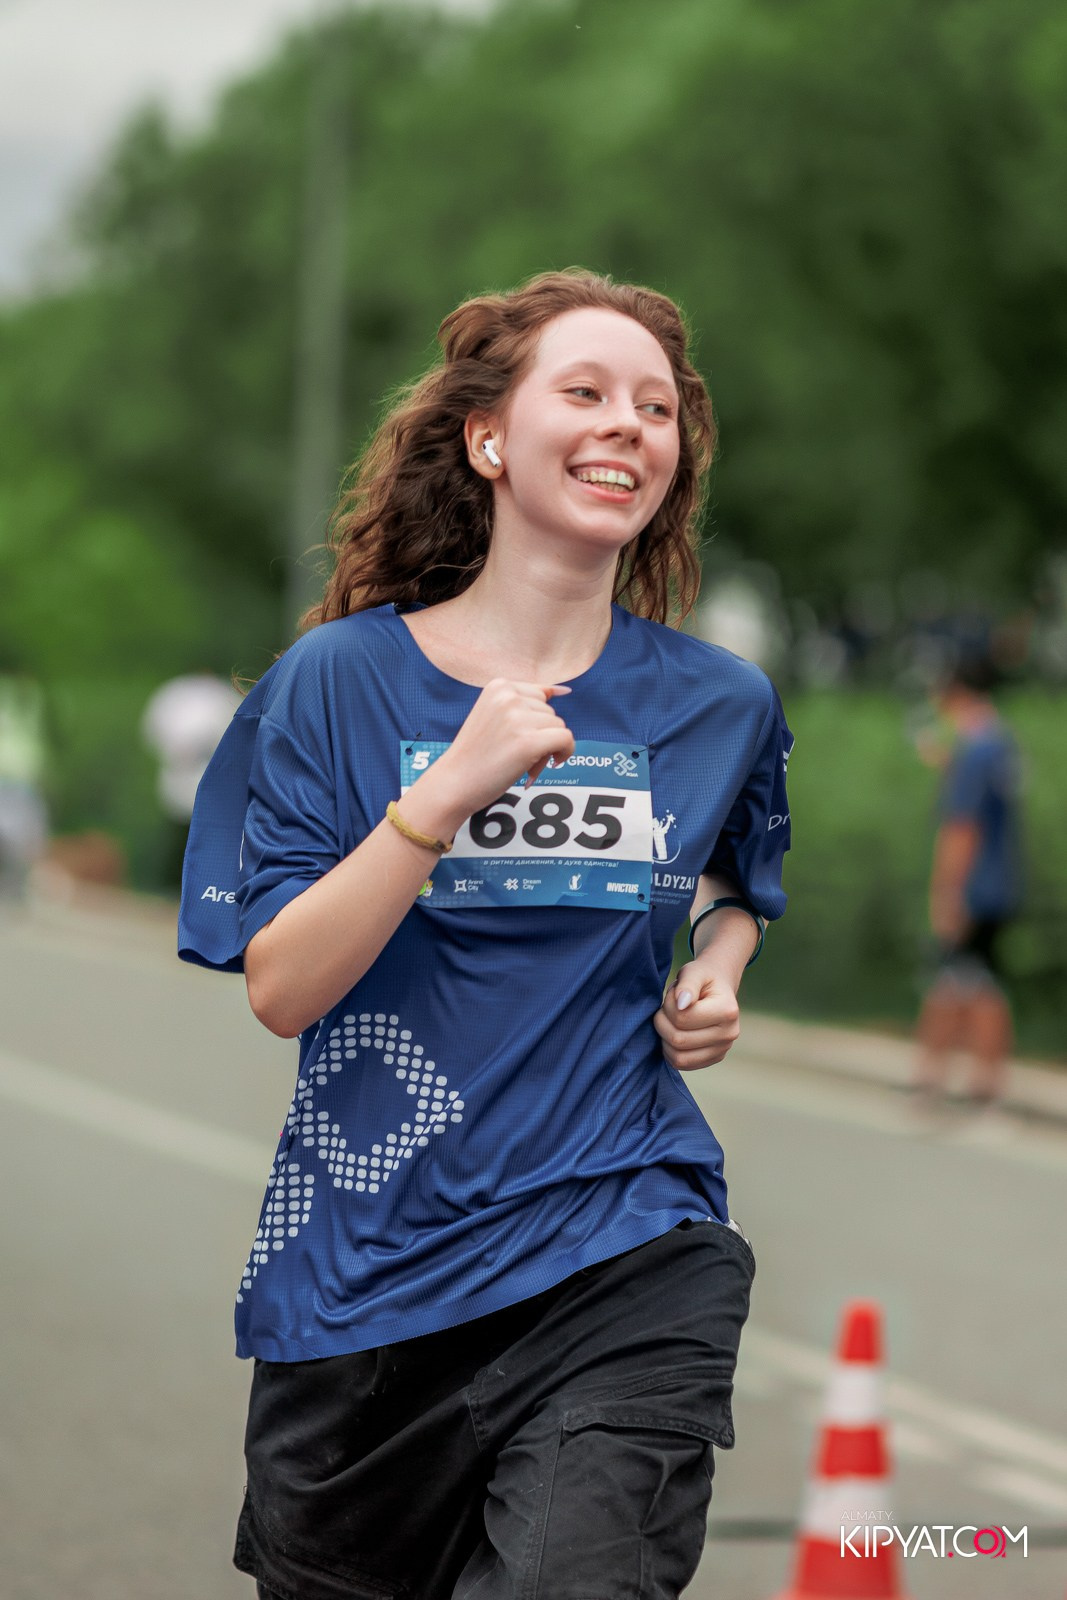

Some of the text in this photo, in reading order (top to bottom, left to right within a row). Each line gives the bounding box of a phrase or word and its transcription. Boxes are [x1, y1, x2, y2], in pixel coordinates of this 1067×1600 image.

[411, 751, 431, 770] 5
[566, 755, 613, 767] GROUP
[453, 792, 626, 851] 685
[606, 882, 640, 894] INVICTUS
[651, 872, 696, 890] LDYZAI
